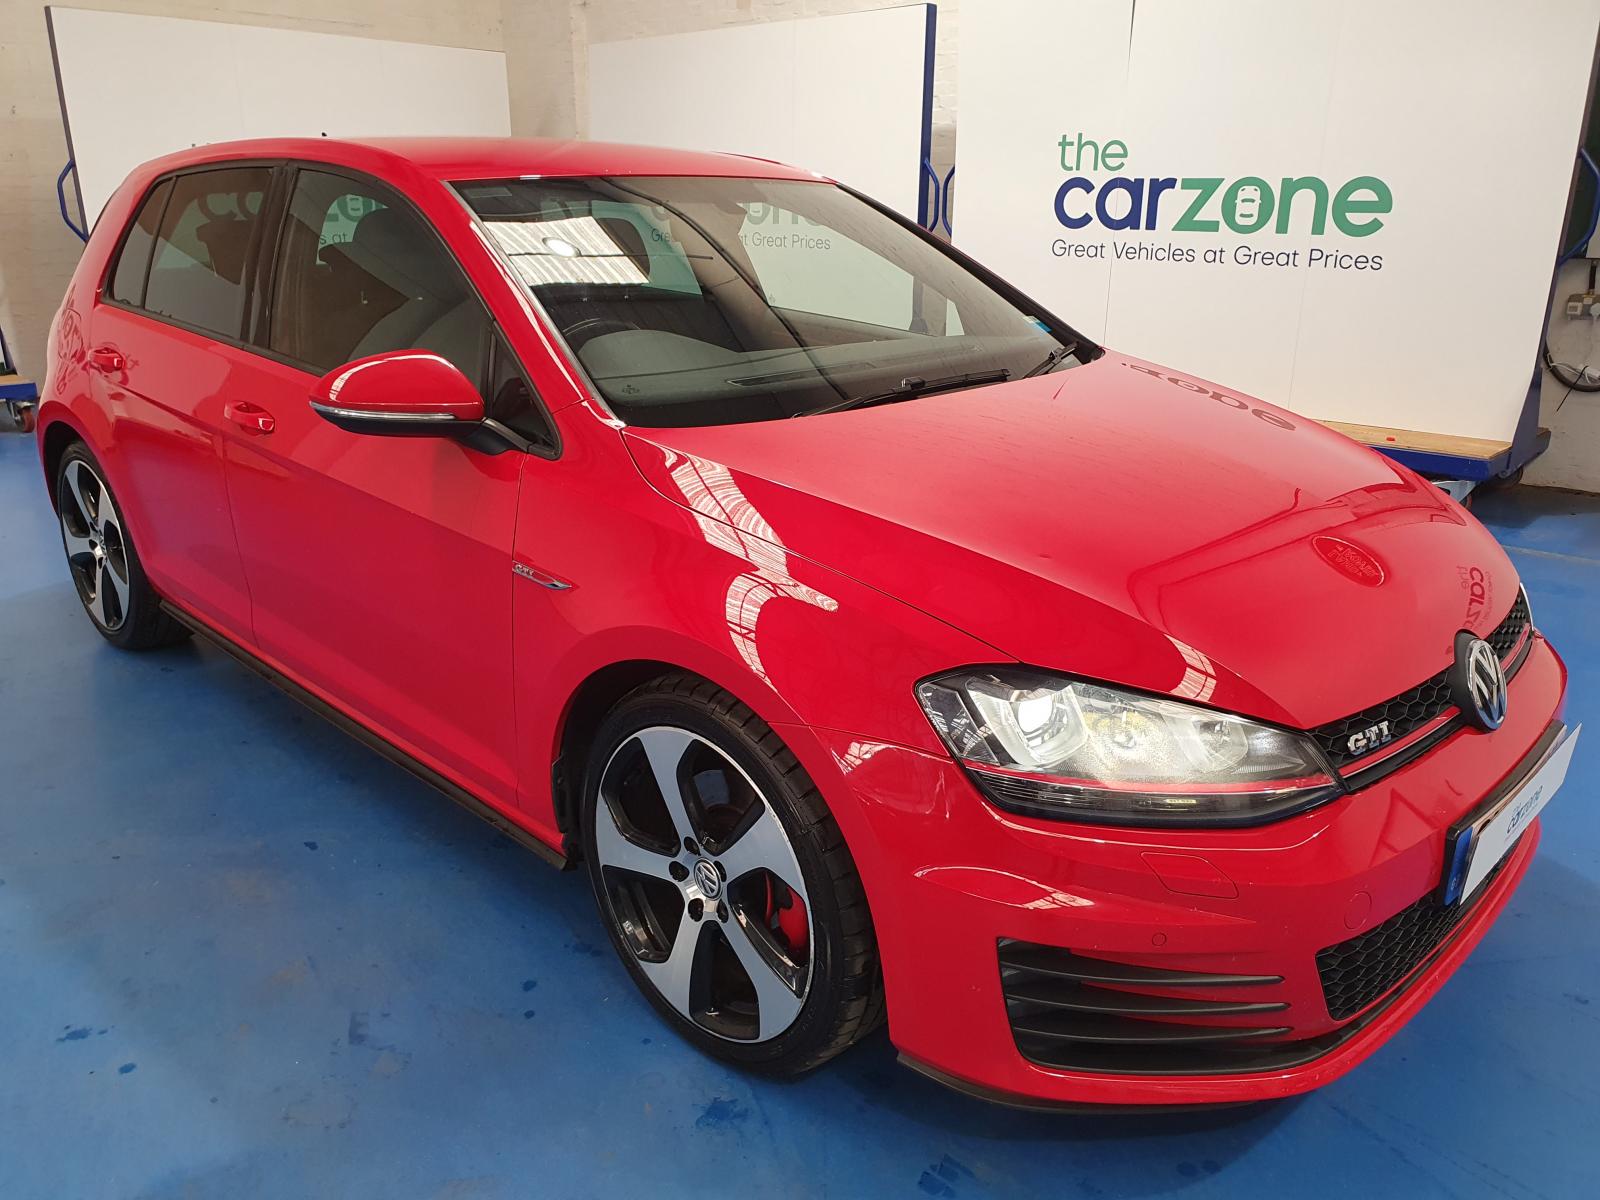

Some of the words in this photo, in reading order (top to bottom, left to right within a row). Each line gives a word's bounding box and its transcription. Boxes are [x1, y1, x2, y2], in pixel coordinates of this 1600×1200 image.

[1058, 132, 1128, 171] the
[1054, 175, 1393, 238] carzone
[651, 227, 671, 242] Gre
[752, 231, 788, 248] Great
[792, 234, 831, 250] Prices
[1051, 238, 1106, 260] Great
[1113, 241, 1196, 265] Vehicles
[1203, 249, 1226, 265] at
[1233, 245, 1299, 269] Great
[1308, 248, 1384, 272] Prices
[1347, 720, 1392, 756] GTI
